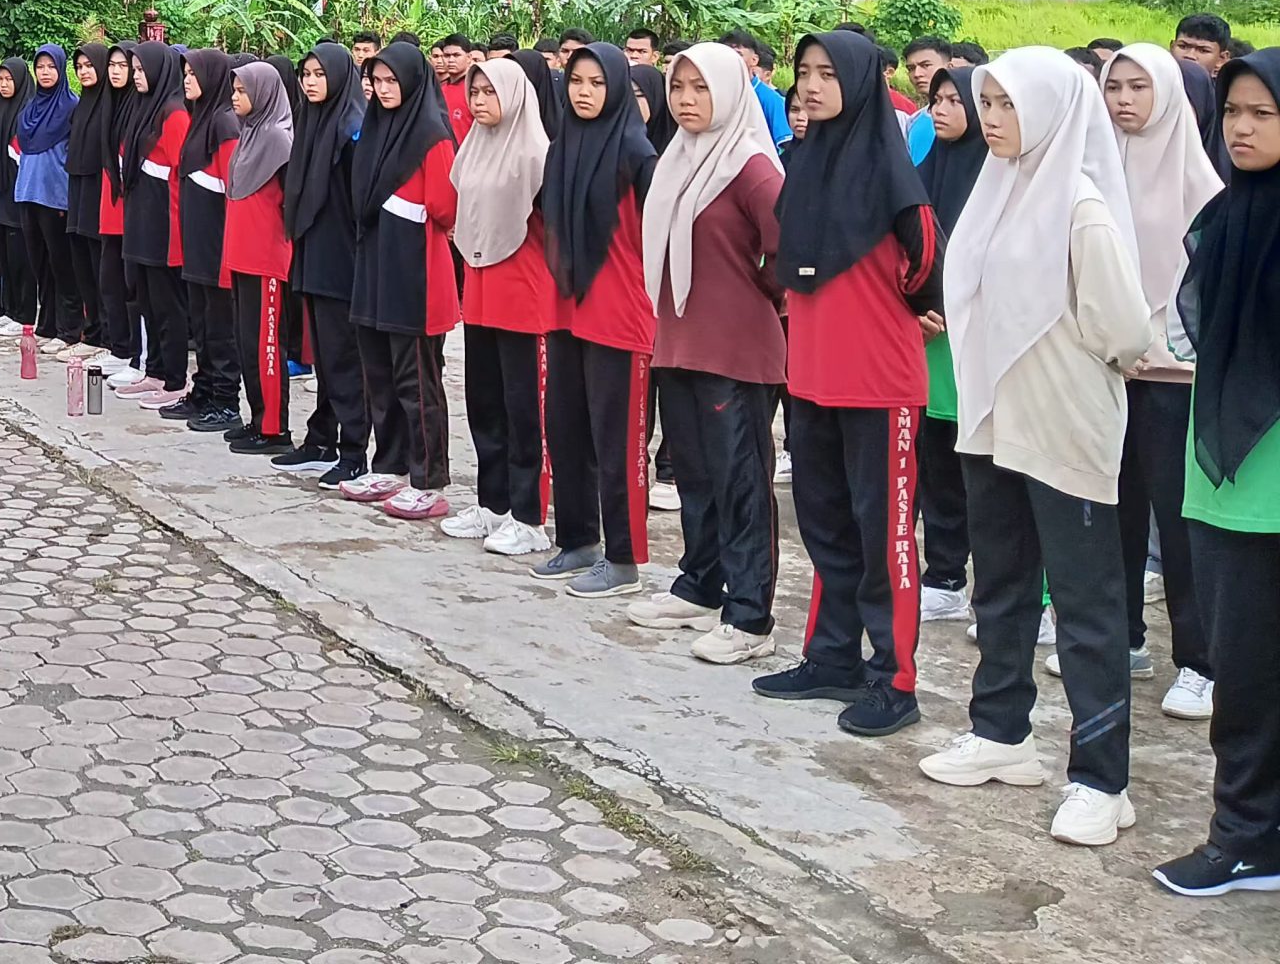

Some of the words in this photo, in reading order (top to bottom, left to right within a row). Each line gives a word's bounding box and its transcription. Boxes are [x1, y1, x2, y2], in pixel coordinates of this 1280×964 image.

[267, 307, 276, 344] PASIE
[266, 345, 276, 376] RAJA
[897, 407, 912, 452] SMAN
[637, 433, 646, 488] SELATAN
[899, 457, 907, 469] 1
[896, 476, 909, 536] PASIE
[895, 540, 911, 589] RAJA
